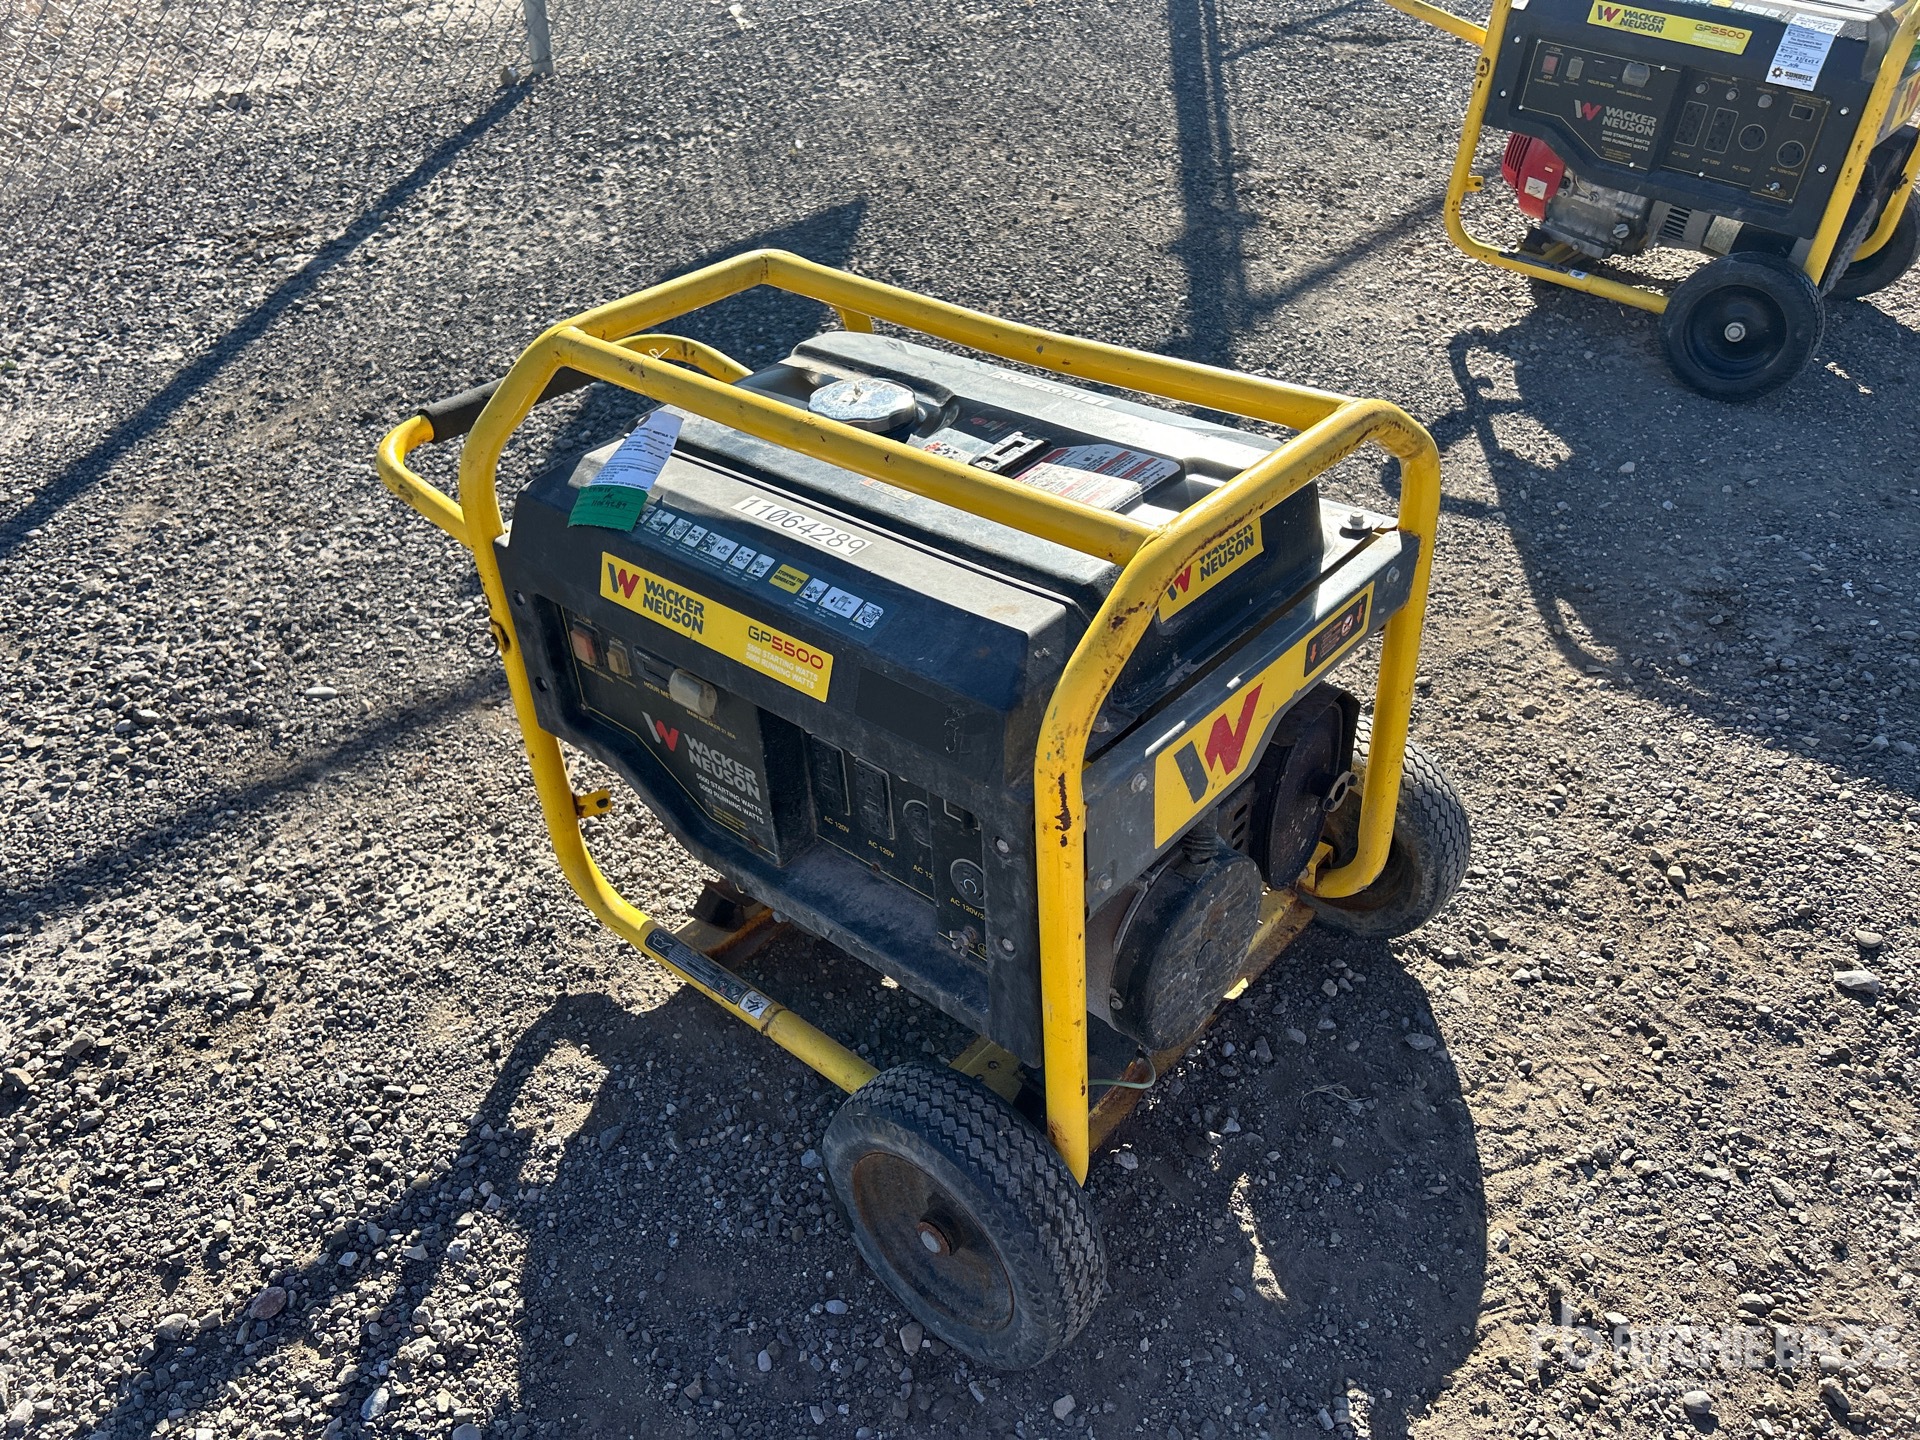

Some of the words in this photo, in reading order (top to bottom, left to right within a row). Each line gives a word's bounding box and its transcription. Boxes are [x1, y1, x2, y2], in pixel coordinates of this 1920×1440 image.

[1619, 17, 1665, 34] NEUSON
[1623, 9, 1667, 26] WACKER
[1694, 23, 1746, 40] GP5500
[1601, 115, 1656, 137] NEUSON
[1605, 105, 1657, 127] WACKER
[740, 499, 866, 555] 11064289
[1199, 531, 1255, 582] NEUSON
[642, 593, 704, 635] NEUSON
[644, 577, 705, 619] WACKER
[748, 625, 824, 670] GP5500
[761, 649, 795, 671] STARTING
[795, 664, 819, 682] WATTS
[761, 658, 791, 679] RUNNING
[791, 673, 815, 690] WATTS
[660, 689, 673, 700] MET
[684, 733, 758, 786] WACKER
[687, 749, 761, 801] NEUSON
[710, 781, 741, 802] STARTING
[741, 798, 763, 815] WATTS
[713, 791, 742, 812] RUNNING
[742, 808, 765, 825] WATTS
[824, 815, 834, 825] AC
[834, 821, 850, 833] 120V
[868, 839, 878, 849] AC
[879, 846, 895, 858] 120V
[912, 864, 924, 875] AC
[950, 897, 961, 907] AC
[962, 903, 986, 921] 120V/2
